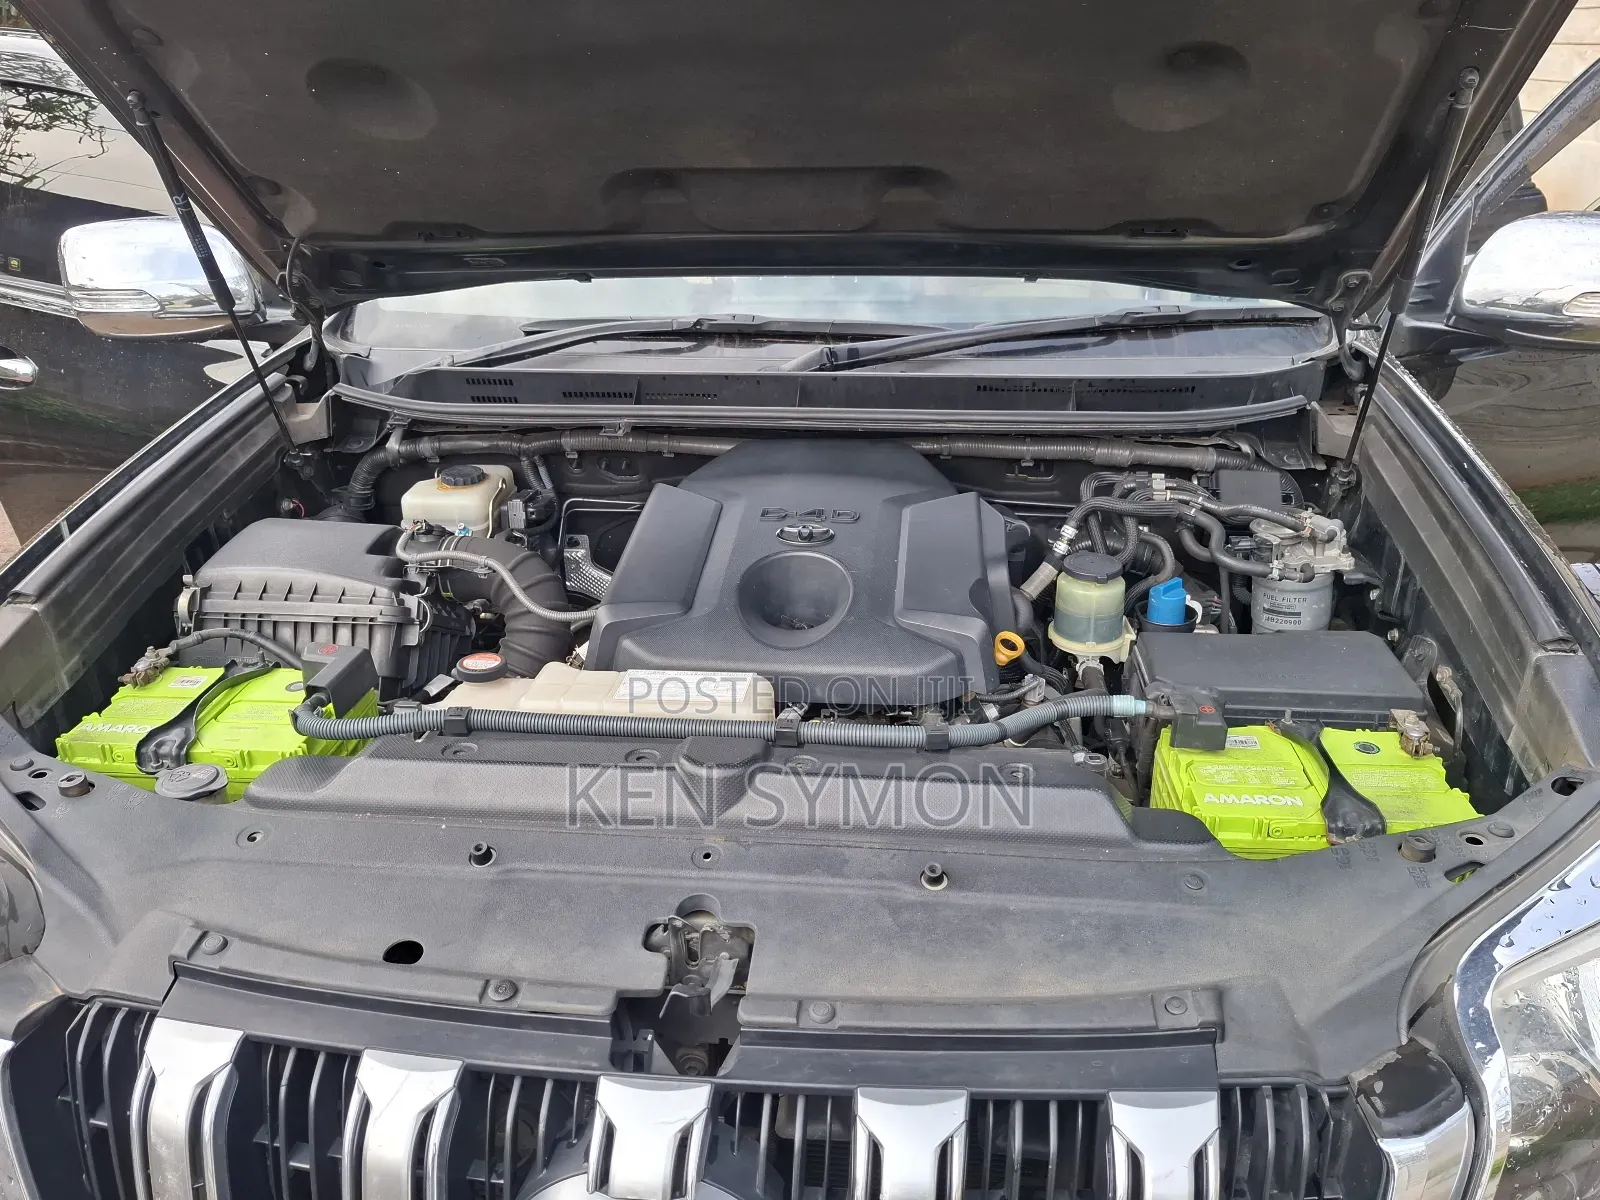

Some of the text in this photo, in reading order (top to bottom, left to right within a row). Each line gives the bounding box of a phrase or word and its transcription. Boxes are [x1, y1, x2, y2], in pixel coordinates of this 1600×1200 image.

[760, 507, 861, 523] D-4D
[1263, 592, 1279, 602] FUEL
[78, 723, 152, 734] AMARO
[1203, 793, 1304, 806] AMARON
